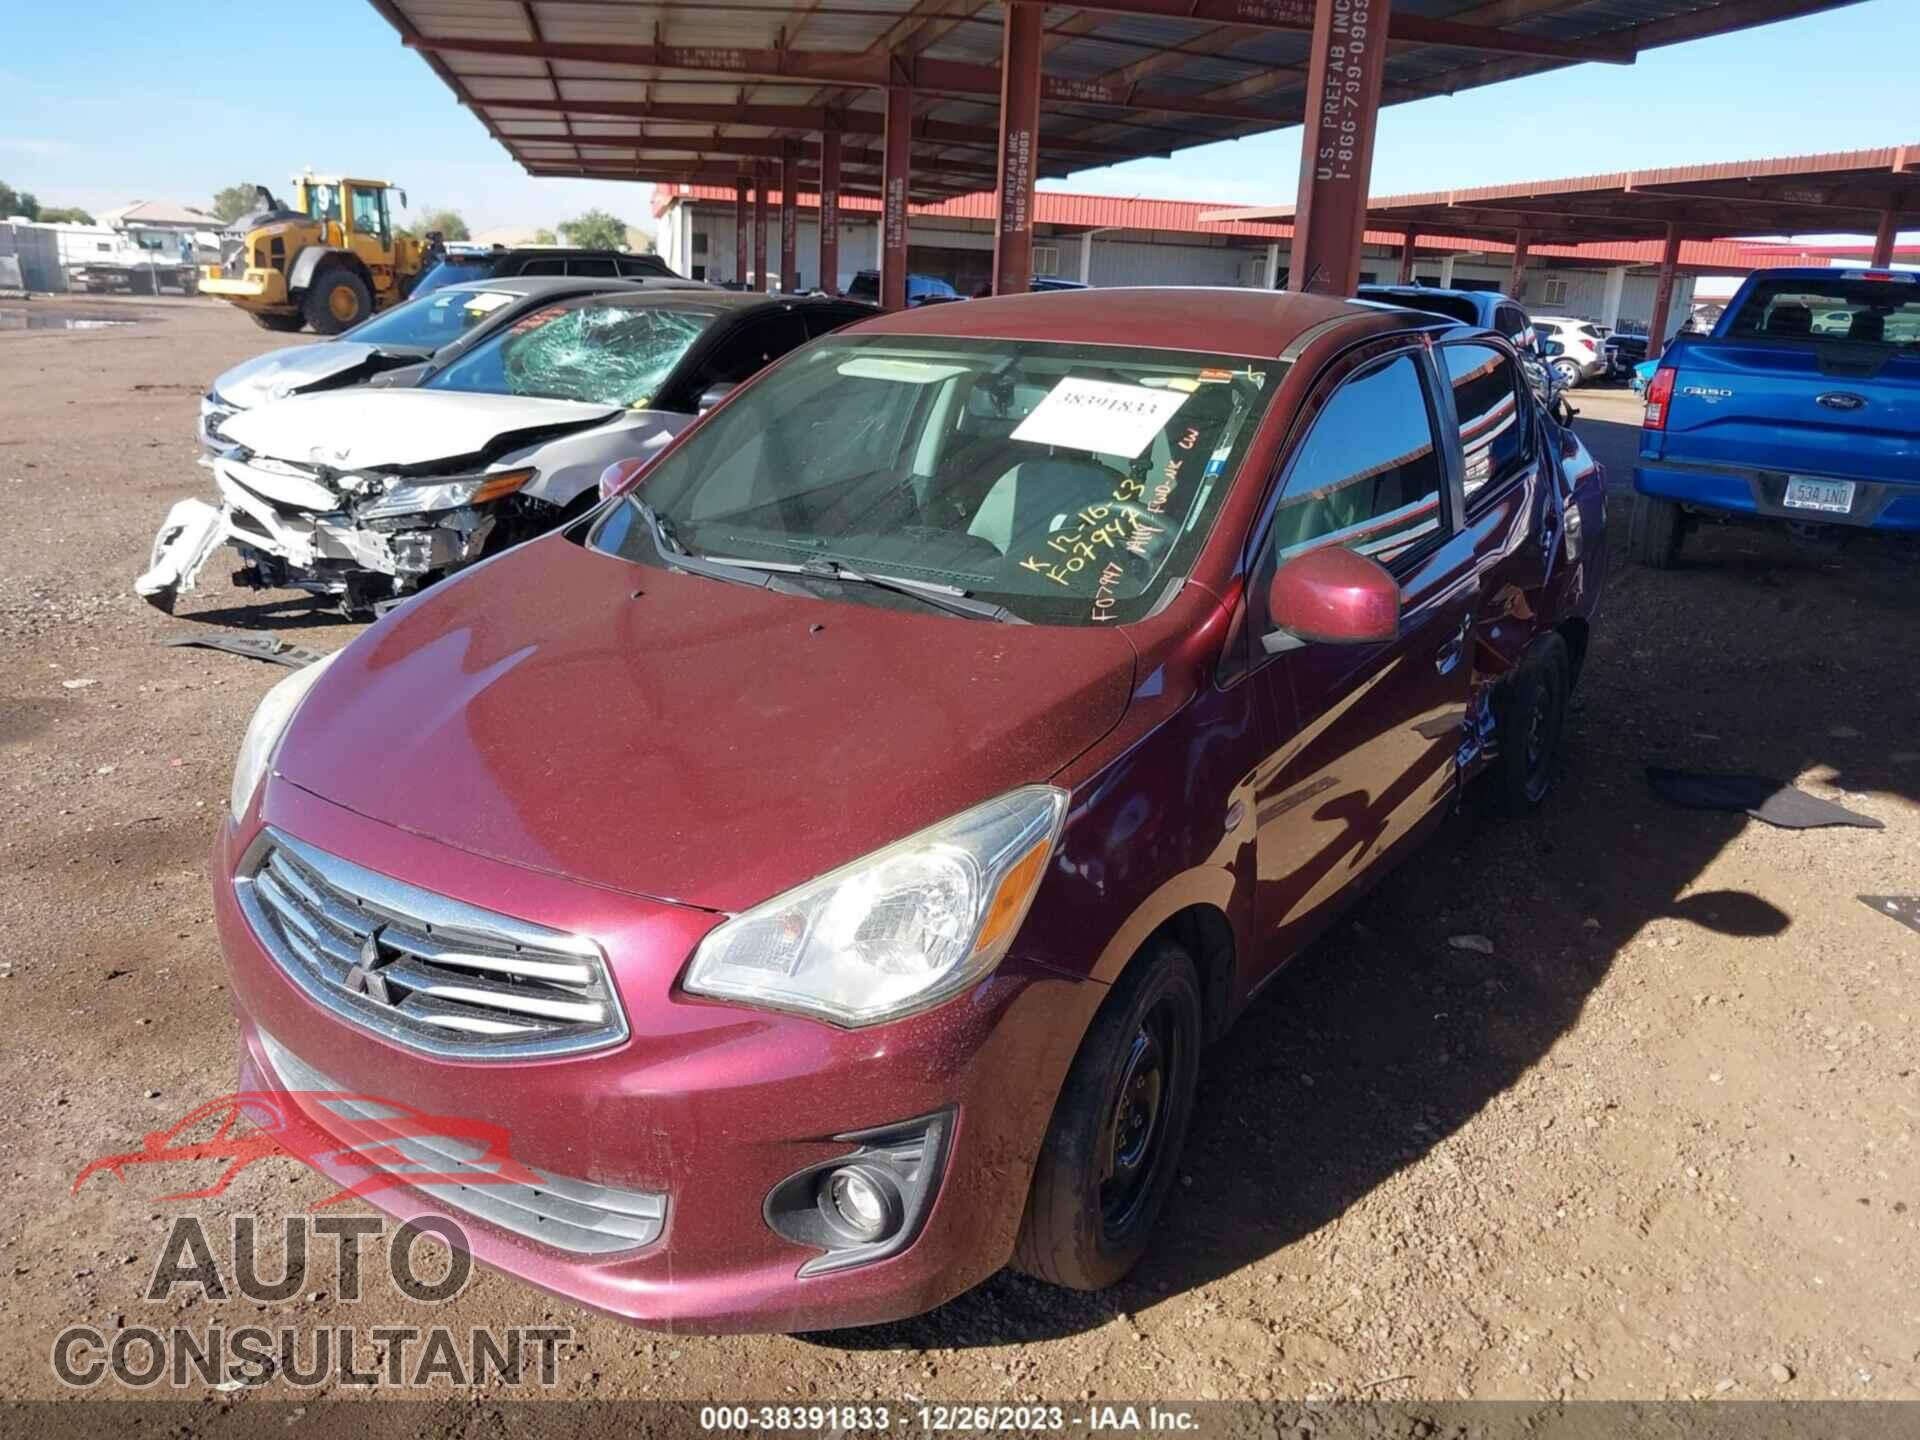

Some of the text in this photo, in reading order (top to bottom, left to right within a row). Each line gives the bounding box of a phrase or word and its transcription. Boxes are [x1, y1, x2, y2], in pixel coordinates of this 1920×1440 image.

[1323, 46, 1345, 128] PREFAB
[1317, 141, 1336, 180] U.S.
[1063, 391, 1158, 416] 38391833
